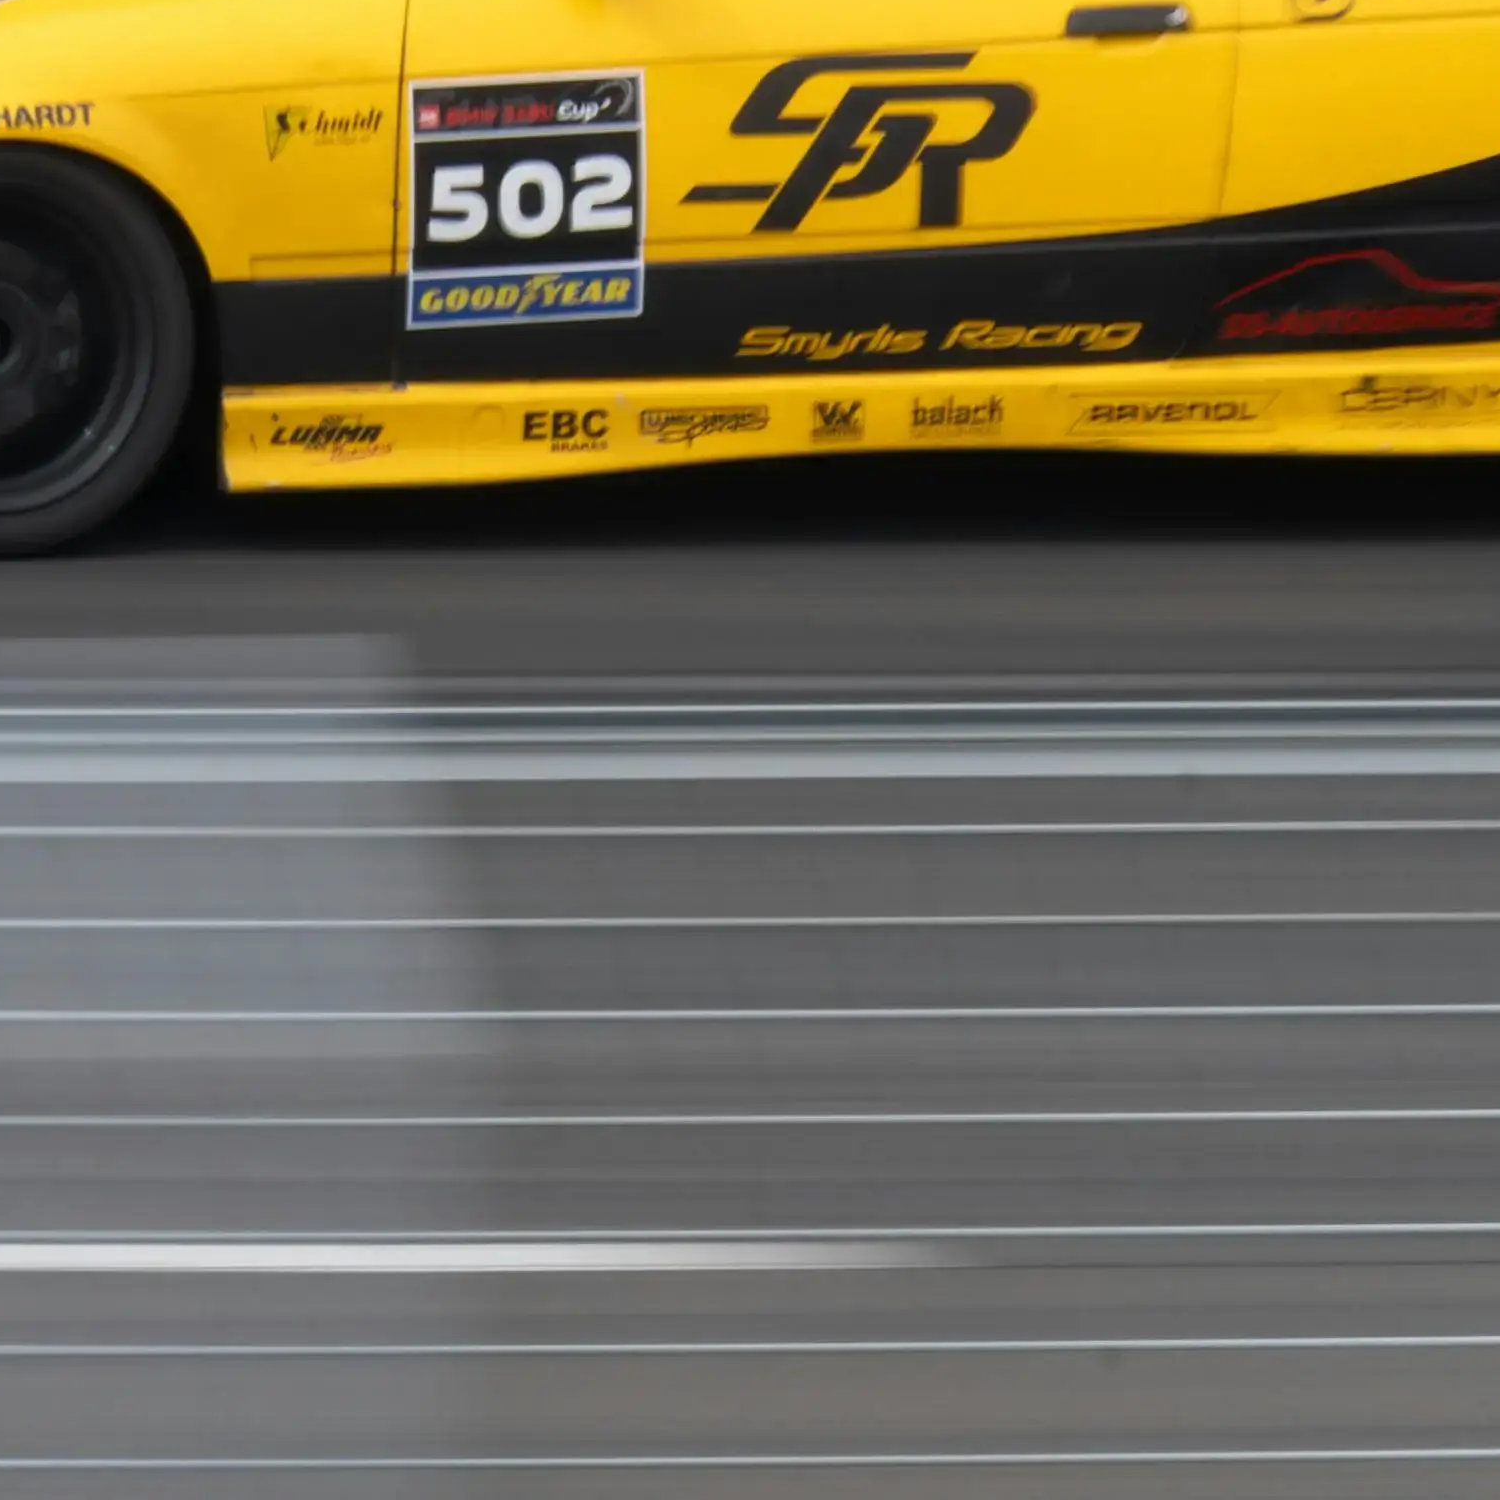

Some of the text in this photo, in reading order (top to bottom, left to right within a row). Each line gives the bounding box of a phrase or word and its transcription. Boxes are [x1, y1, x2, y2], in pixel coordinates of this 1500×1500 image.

[678, 51, 1037, 233] SPR
[426, 153, 635, 243] 502
[938, 319, 1143, 352] Racing
[522, 408, 610, 442] EBC
